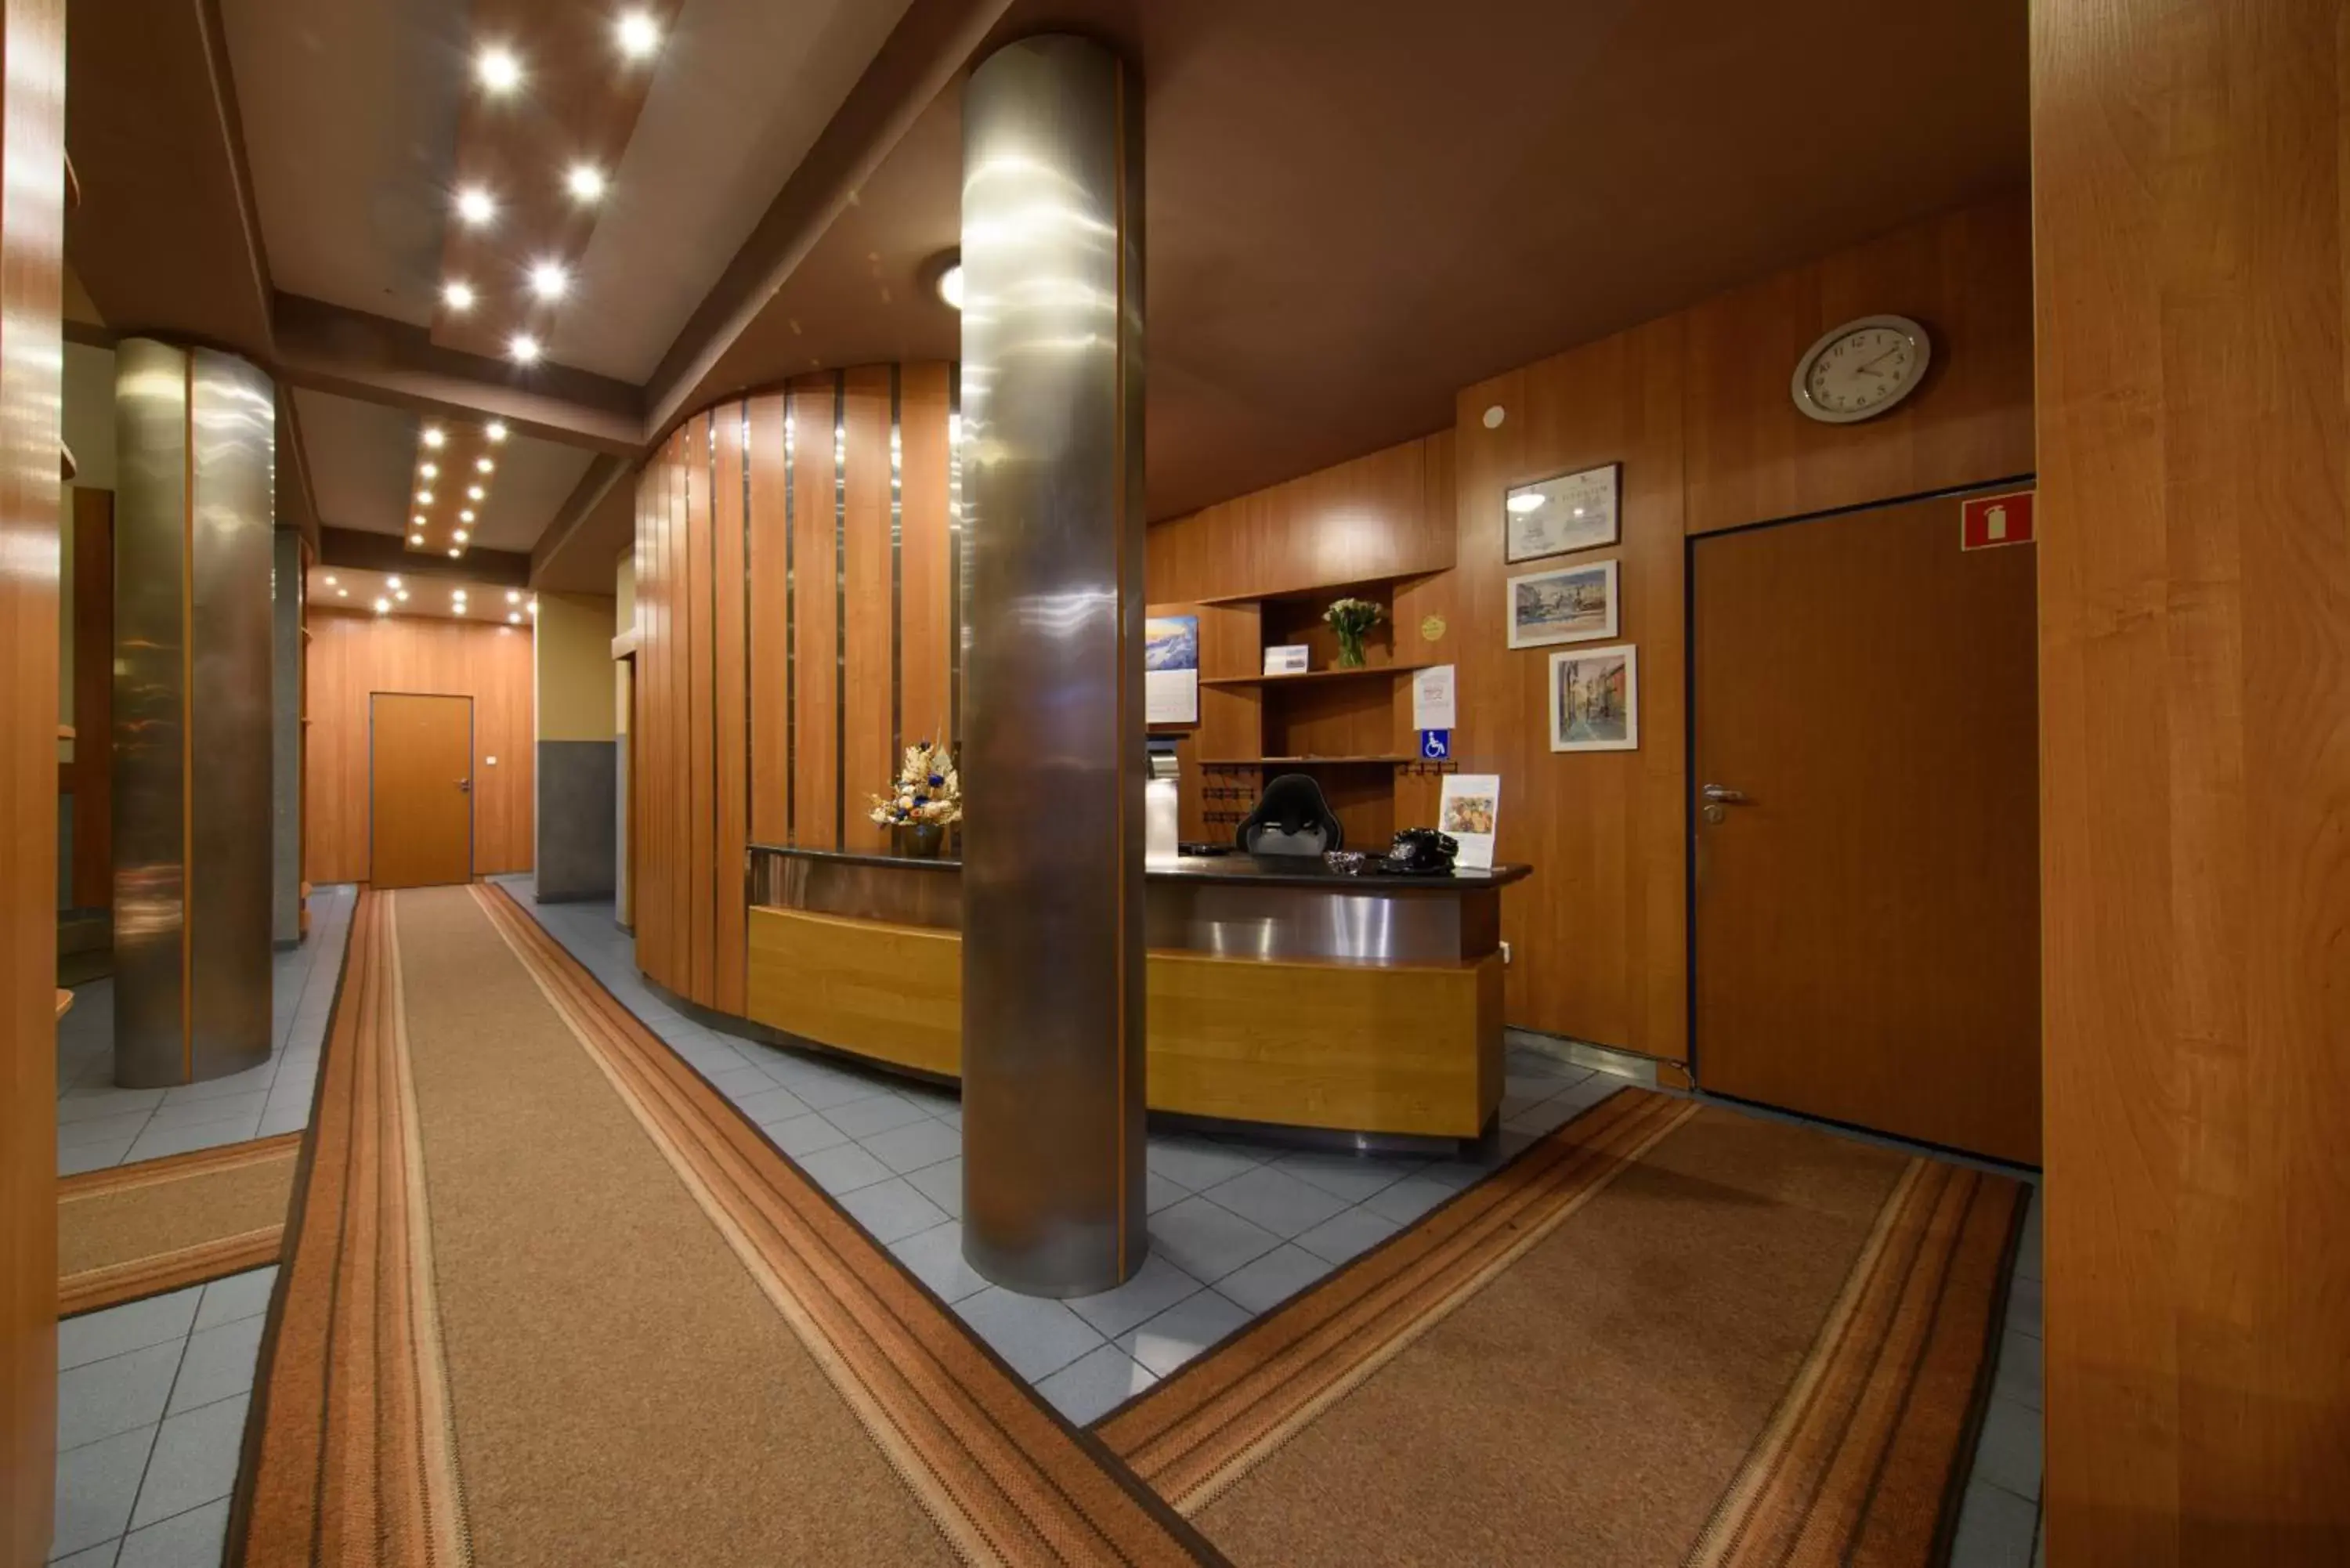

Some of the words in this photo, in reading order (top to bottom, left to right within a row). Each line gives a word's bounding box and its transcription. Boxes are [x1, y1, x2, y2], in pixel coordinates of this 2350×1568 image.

[1852, 336, 1865, 348] 12
[1876, 334, 1882, 345] 1
[1834, 347, 1843, 357] 11
[1896, 352, 1906, 365] 3
[1820, 361, 1831, 374] 10
[1815, 377, 1824, 387] 9
[1877, 385, 1886, 396] 5
[1837, 396, 1846, 406] 7
[1856, 396, 1866, 406] 6
